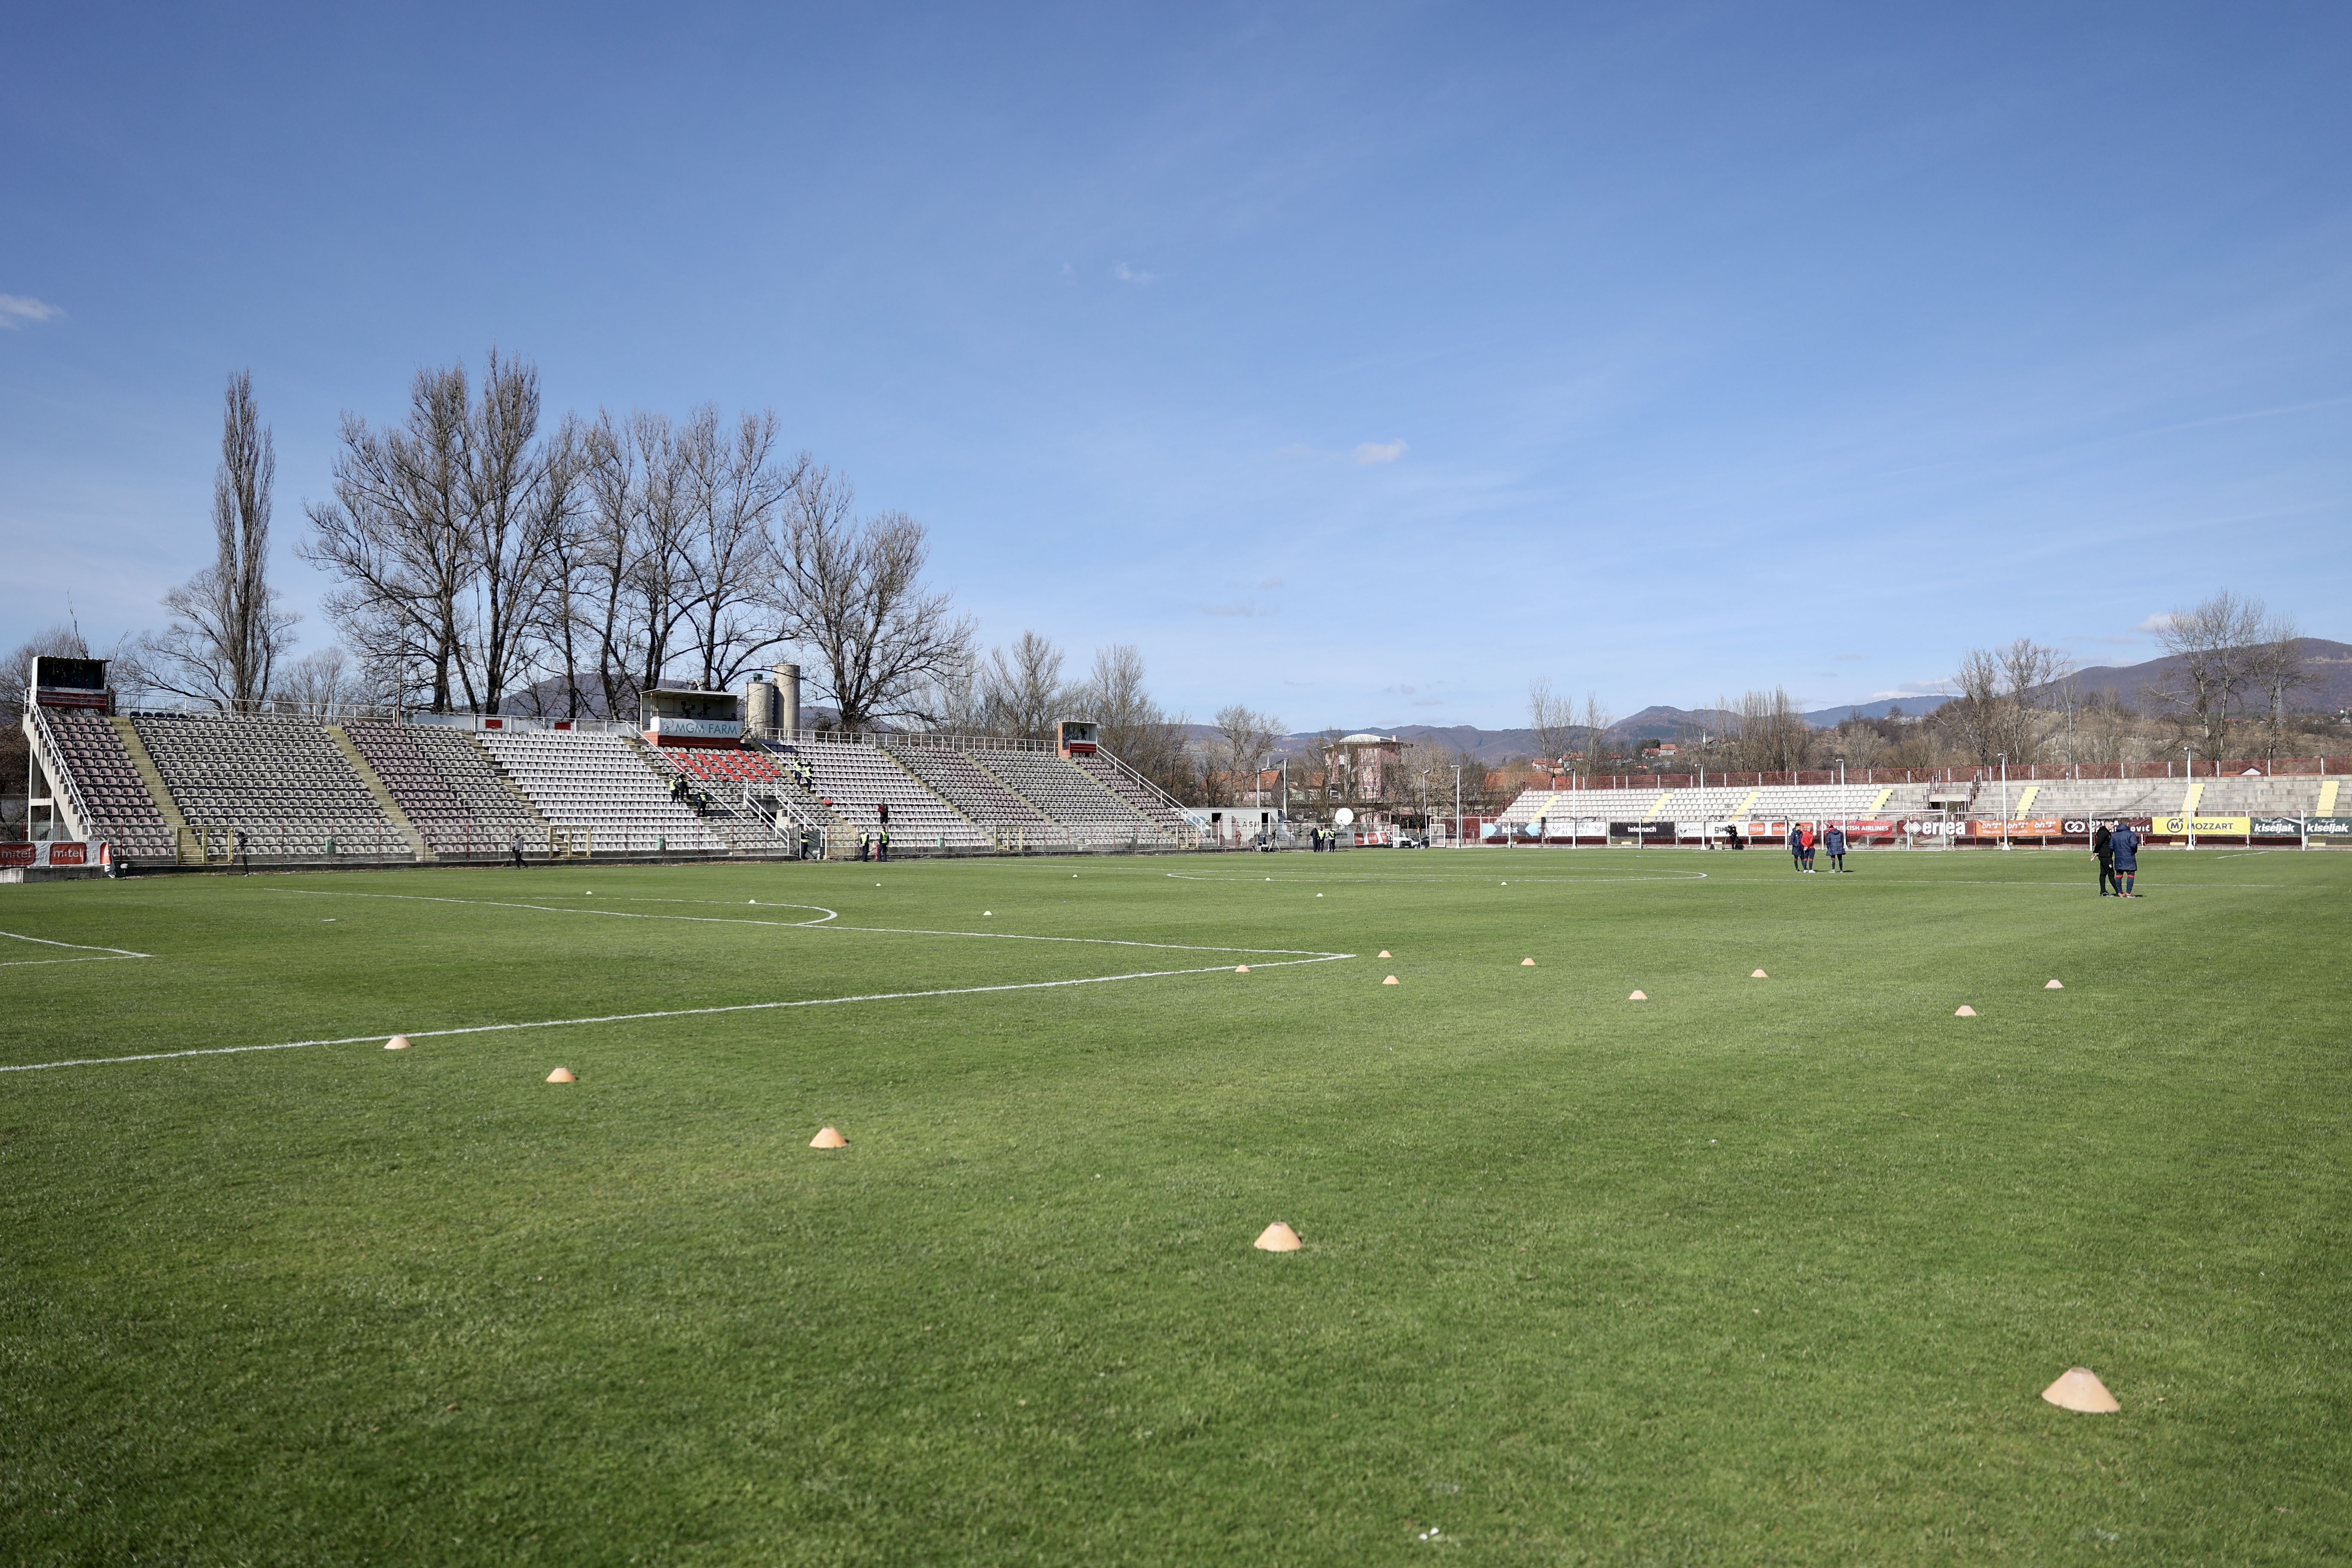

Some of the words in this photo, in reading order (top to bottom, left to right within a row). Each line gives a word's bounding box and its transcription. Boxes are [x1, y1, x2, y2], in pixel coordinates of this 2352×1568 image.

[675, 723, 705, 733] MGM
[709, 724, 737, 735] FARM
[2254, 824, 2295, 833] kiseljak
[2306, 824, 2349, 833] kiseljak
[2, 848, 31, 858] m:tel
[53, 848, 83, 858] m:tel
